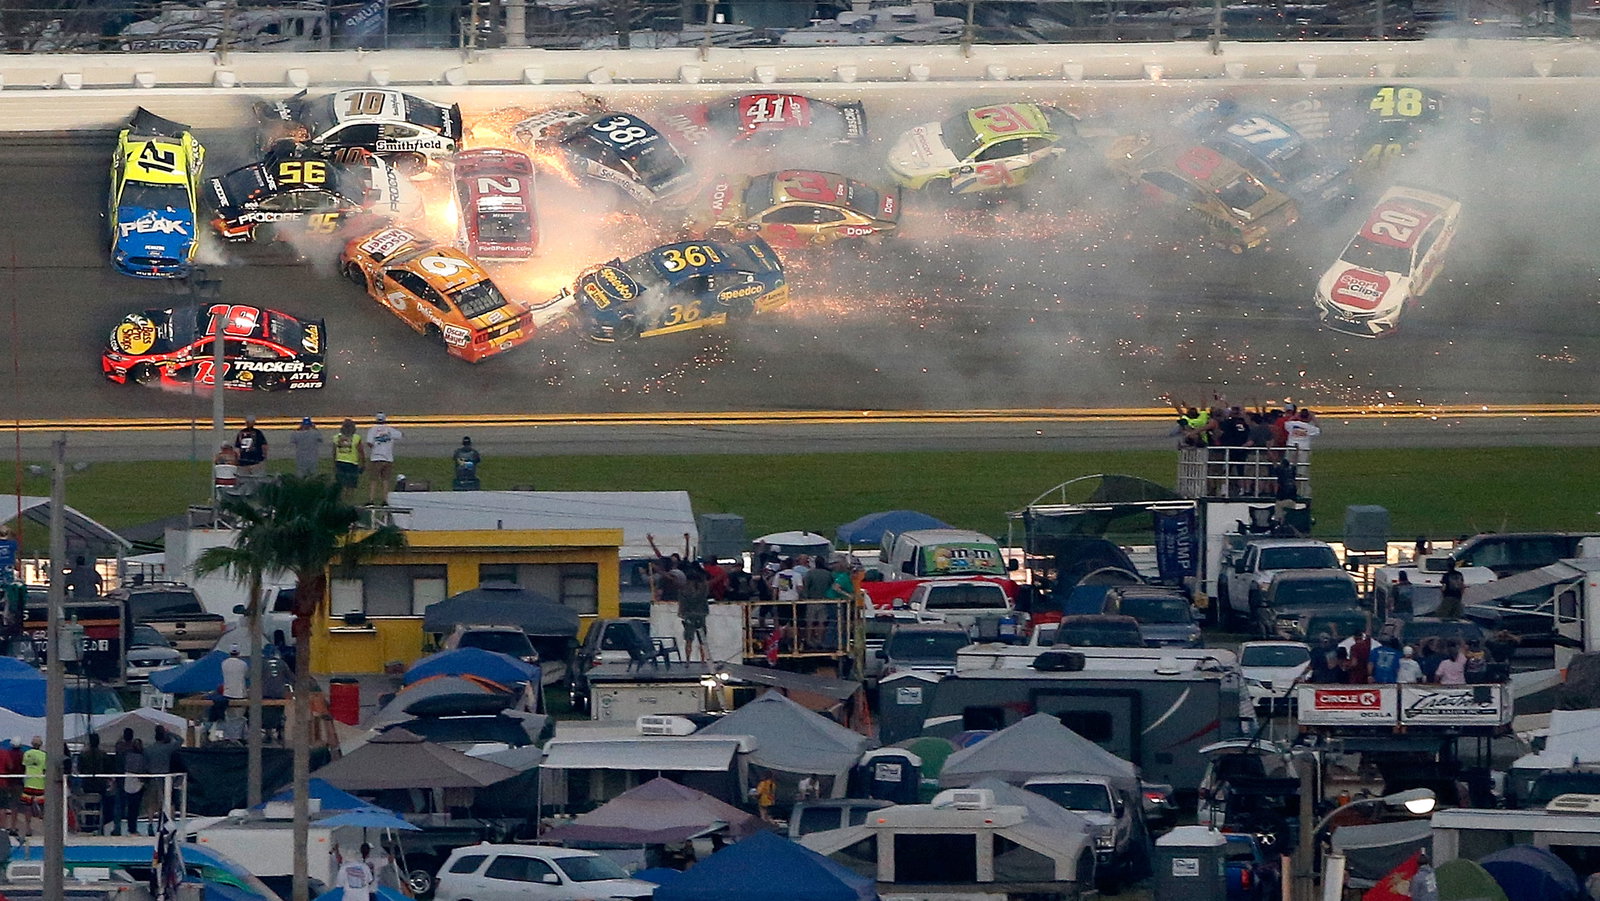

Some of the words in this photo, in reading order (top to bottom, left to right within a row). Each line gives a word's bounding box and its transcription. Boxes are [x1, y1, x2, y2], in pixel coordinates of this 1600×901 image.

[344, 90, 386, 117] 10
[746, 96, 786, 123] 41
[1369, 86, 1422, 116] 48
[592, 116, 647, 144] 38
[974, 105, 1035, 133] 31
[137, 139, 176, 174] 12
[377, 140, 441, 151] Smithfield
[385, 164, 399, 213] PROCOR
[476, 177, 523, 207] 21
[119, 218, 188, 238] PEAK
[238, 211, 302, 225] PROCORE
[304, 213, 340, 236] 95
[1371, 209, 1421, 243] 20
[418, 255, 475, 277] 6
[662, 245, 707, 273] 36
[601, 268, 633, 299] speedco
[719, 285, 762, 301] speedco
[1341, 275, 1379, 289] Sport
[1350, 284, 1380, 297] Clips
[664, 301, 701, 326] 36
[143, 326, 155, 344] Bass
[446, 327, 467, 338] Oscar
[233, 360, 305, 373] TRACKER
[289, 372, 320, 380] ATVs
[289, 382, 323, 390] BOATS
[1177, 521, 1191, 569] TRUMP
[1320, 694, 1359, 703] CIRCLE
